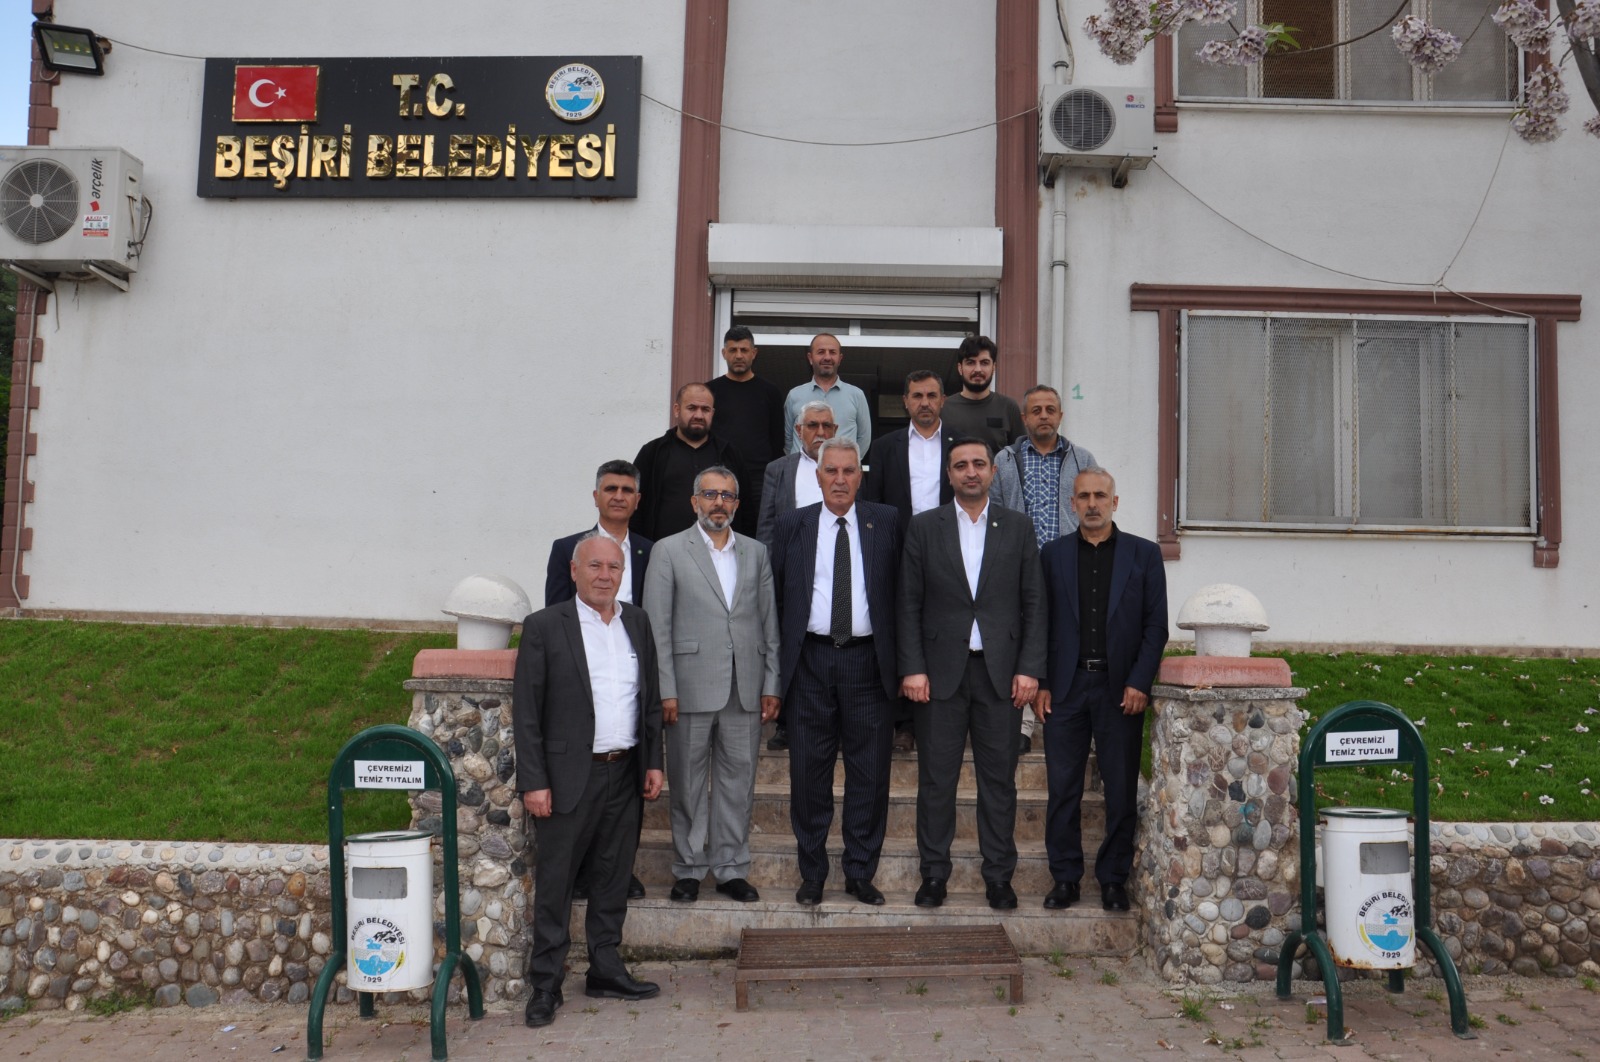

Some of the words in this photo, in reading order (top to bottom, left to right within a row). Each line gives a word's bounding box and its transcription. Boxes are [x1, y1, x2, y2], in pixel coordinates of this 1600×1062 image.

[392, 73, 465, 118] T.C.
[215, 124, 352, 190] BEŞİRİ
[366, 124, 618, 180] BELEDİYESİ
[92, 158, 104, 199] arçelik
[1071, 383, 1084, 400] 1
[1340, 735, 1385, 745] ÇEVREMİZİ
[1330, 748, 1356, 756] TEMİZ
[1358, 747, 1395, 756] TUTALIM
[367, 764, 412, 773] ÇEVREMİZİ
[358, 775, 384, 783] TEMİZ
[1381, 951, 1401, 959] 1929
